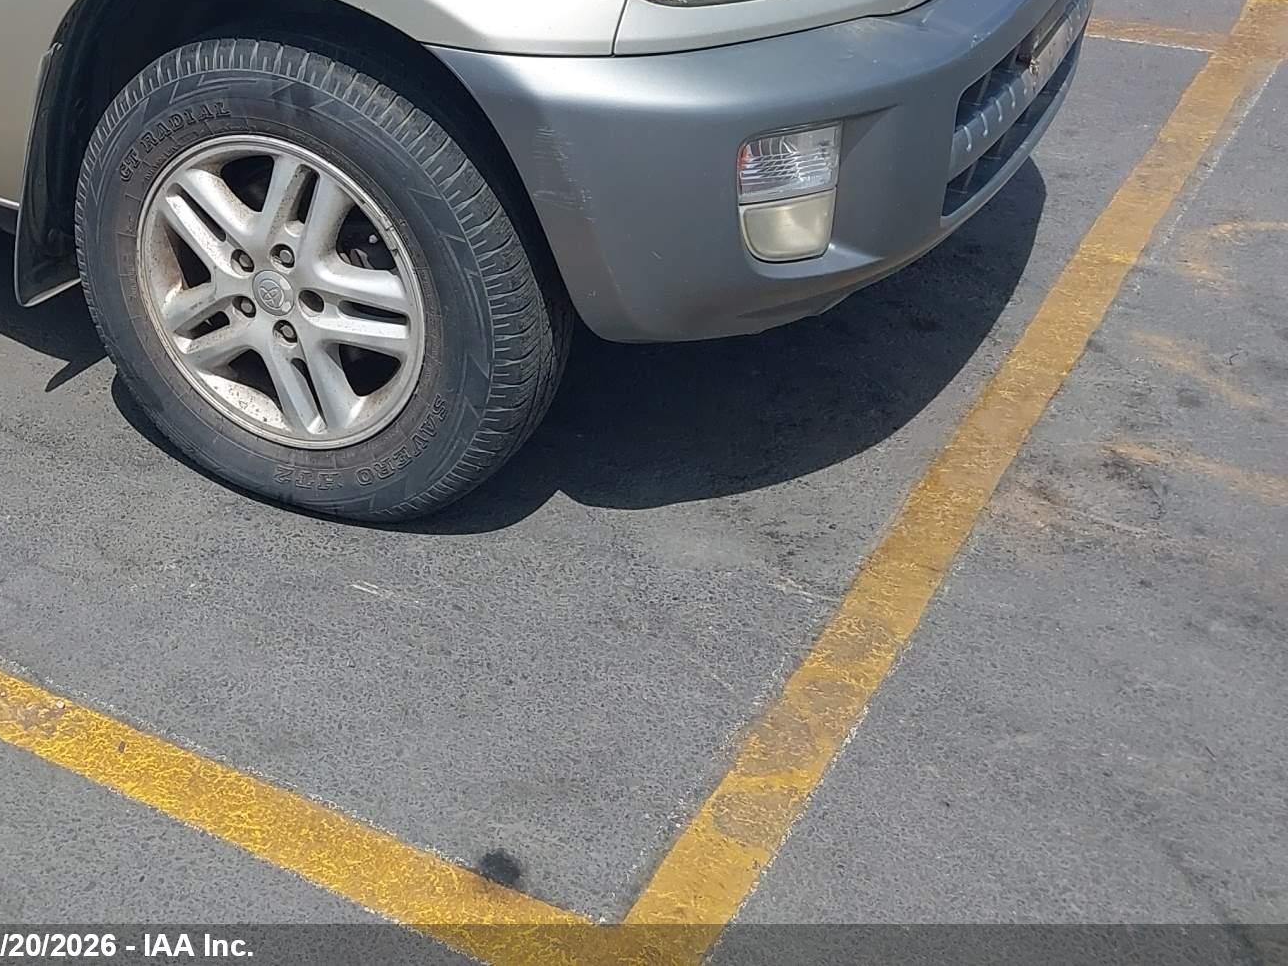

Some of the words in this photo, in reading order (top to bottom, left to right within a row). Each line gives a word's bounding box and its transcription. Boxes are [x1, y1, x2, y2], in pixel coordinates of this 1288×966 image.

[120, 148, 142, 182] GT
[140, 102, 231, 152] RADIAL
[272, 464, 345, 490] HT2
[356, 394, 448, 486] SAVERO
